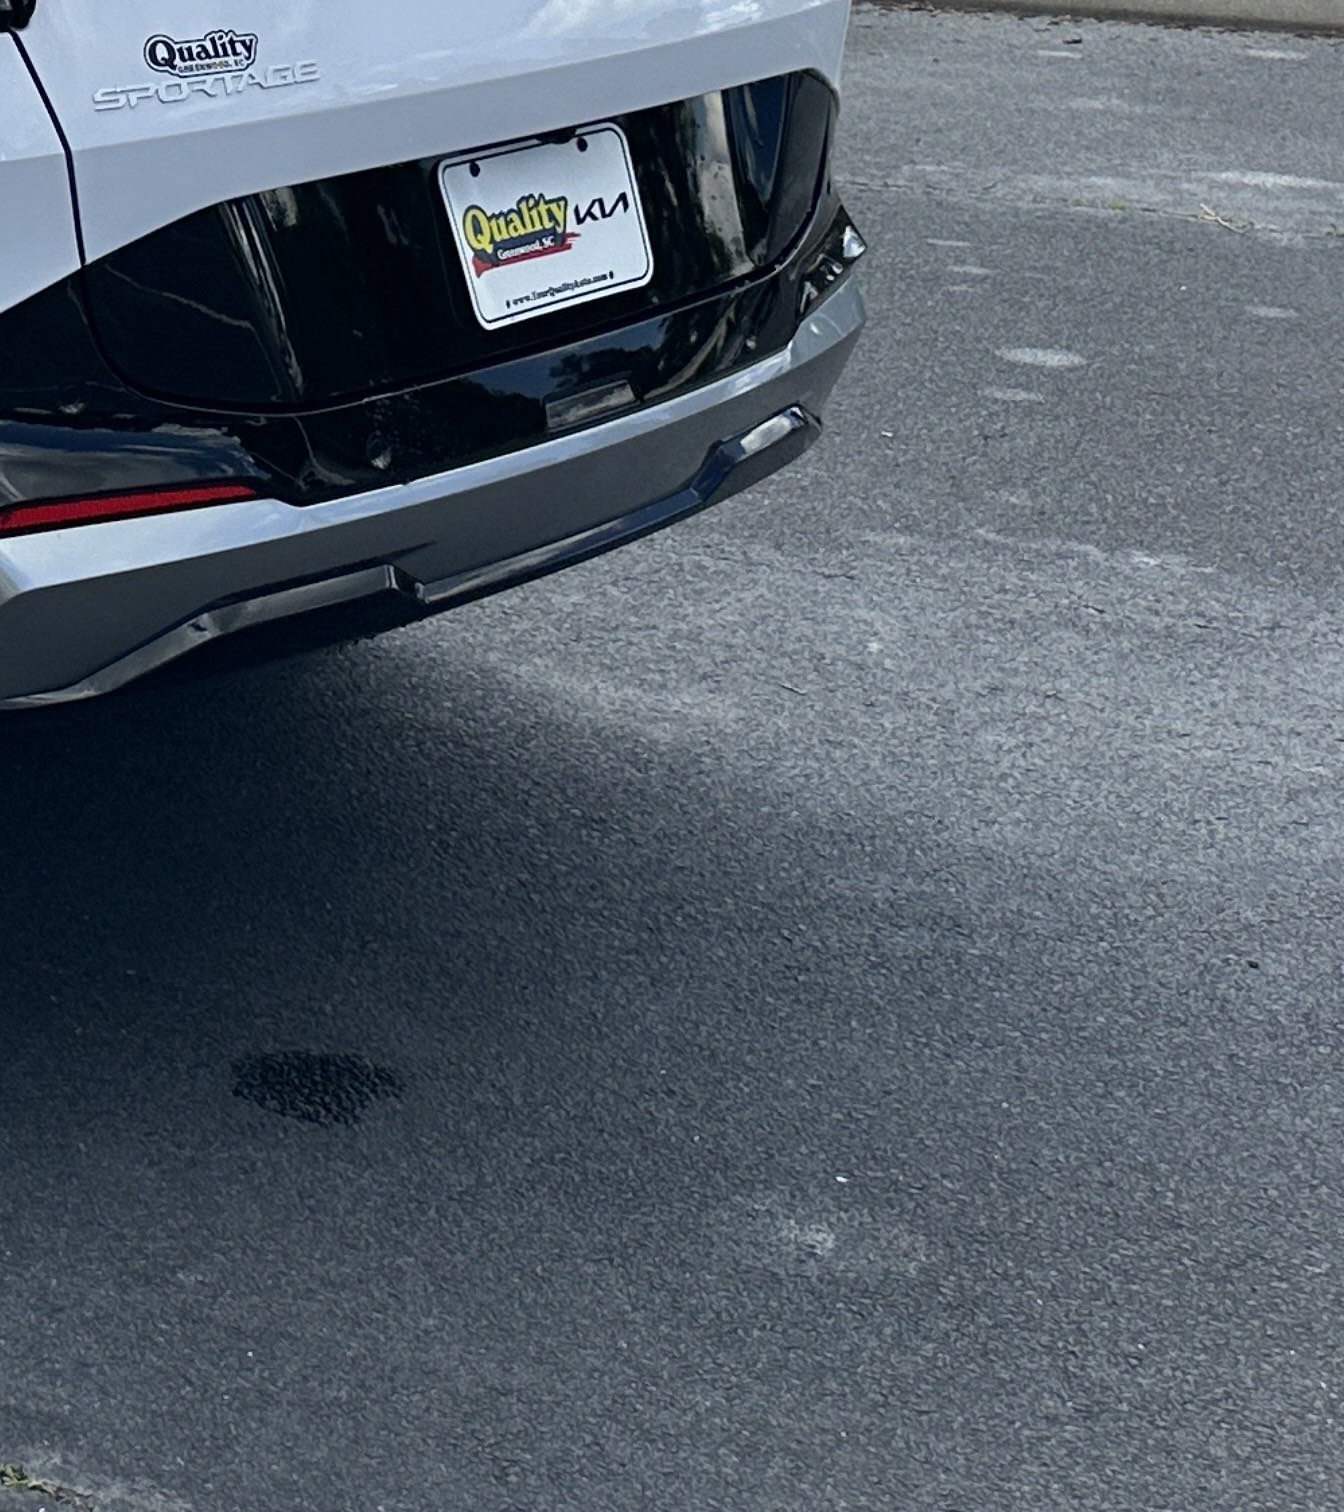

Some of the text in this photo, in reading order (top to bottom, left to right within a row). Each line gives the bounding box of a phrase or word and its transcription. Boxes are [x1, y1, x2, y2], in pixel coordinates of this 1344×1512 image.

[148, 33, 255, 71] Quality
[92, 60, 321, 112] SPORTAGE
[464, 192, 629, 253] Quality KIA
